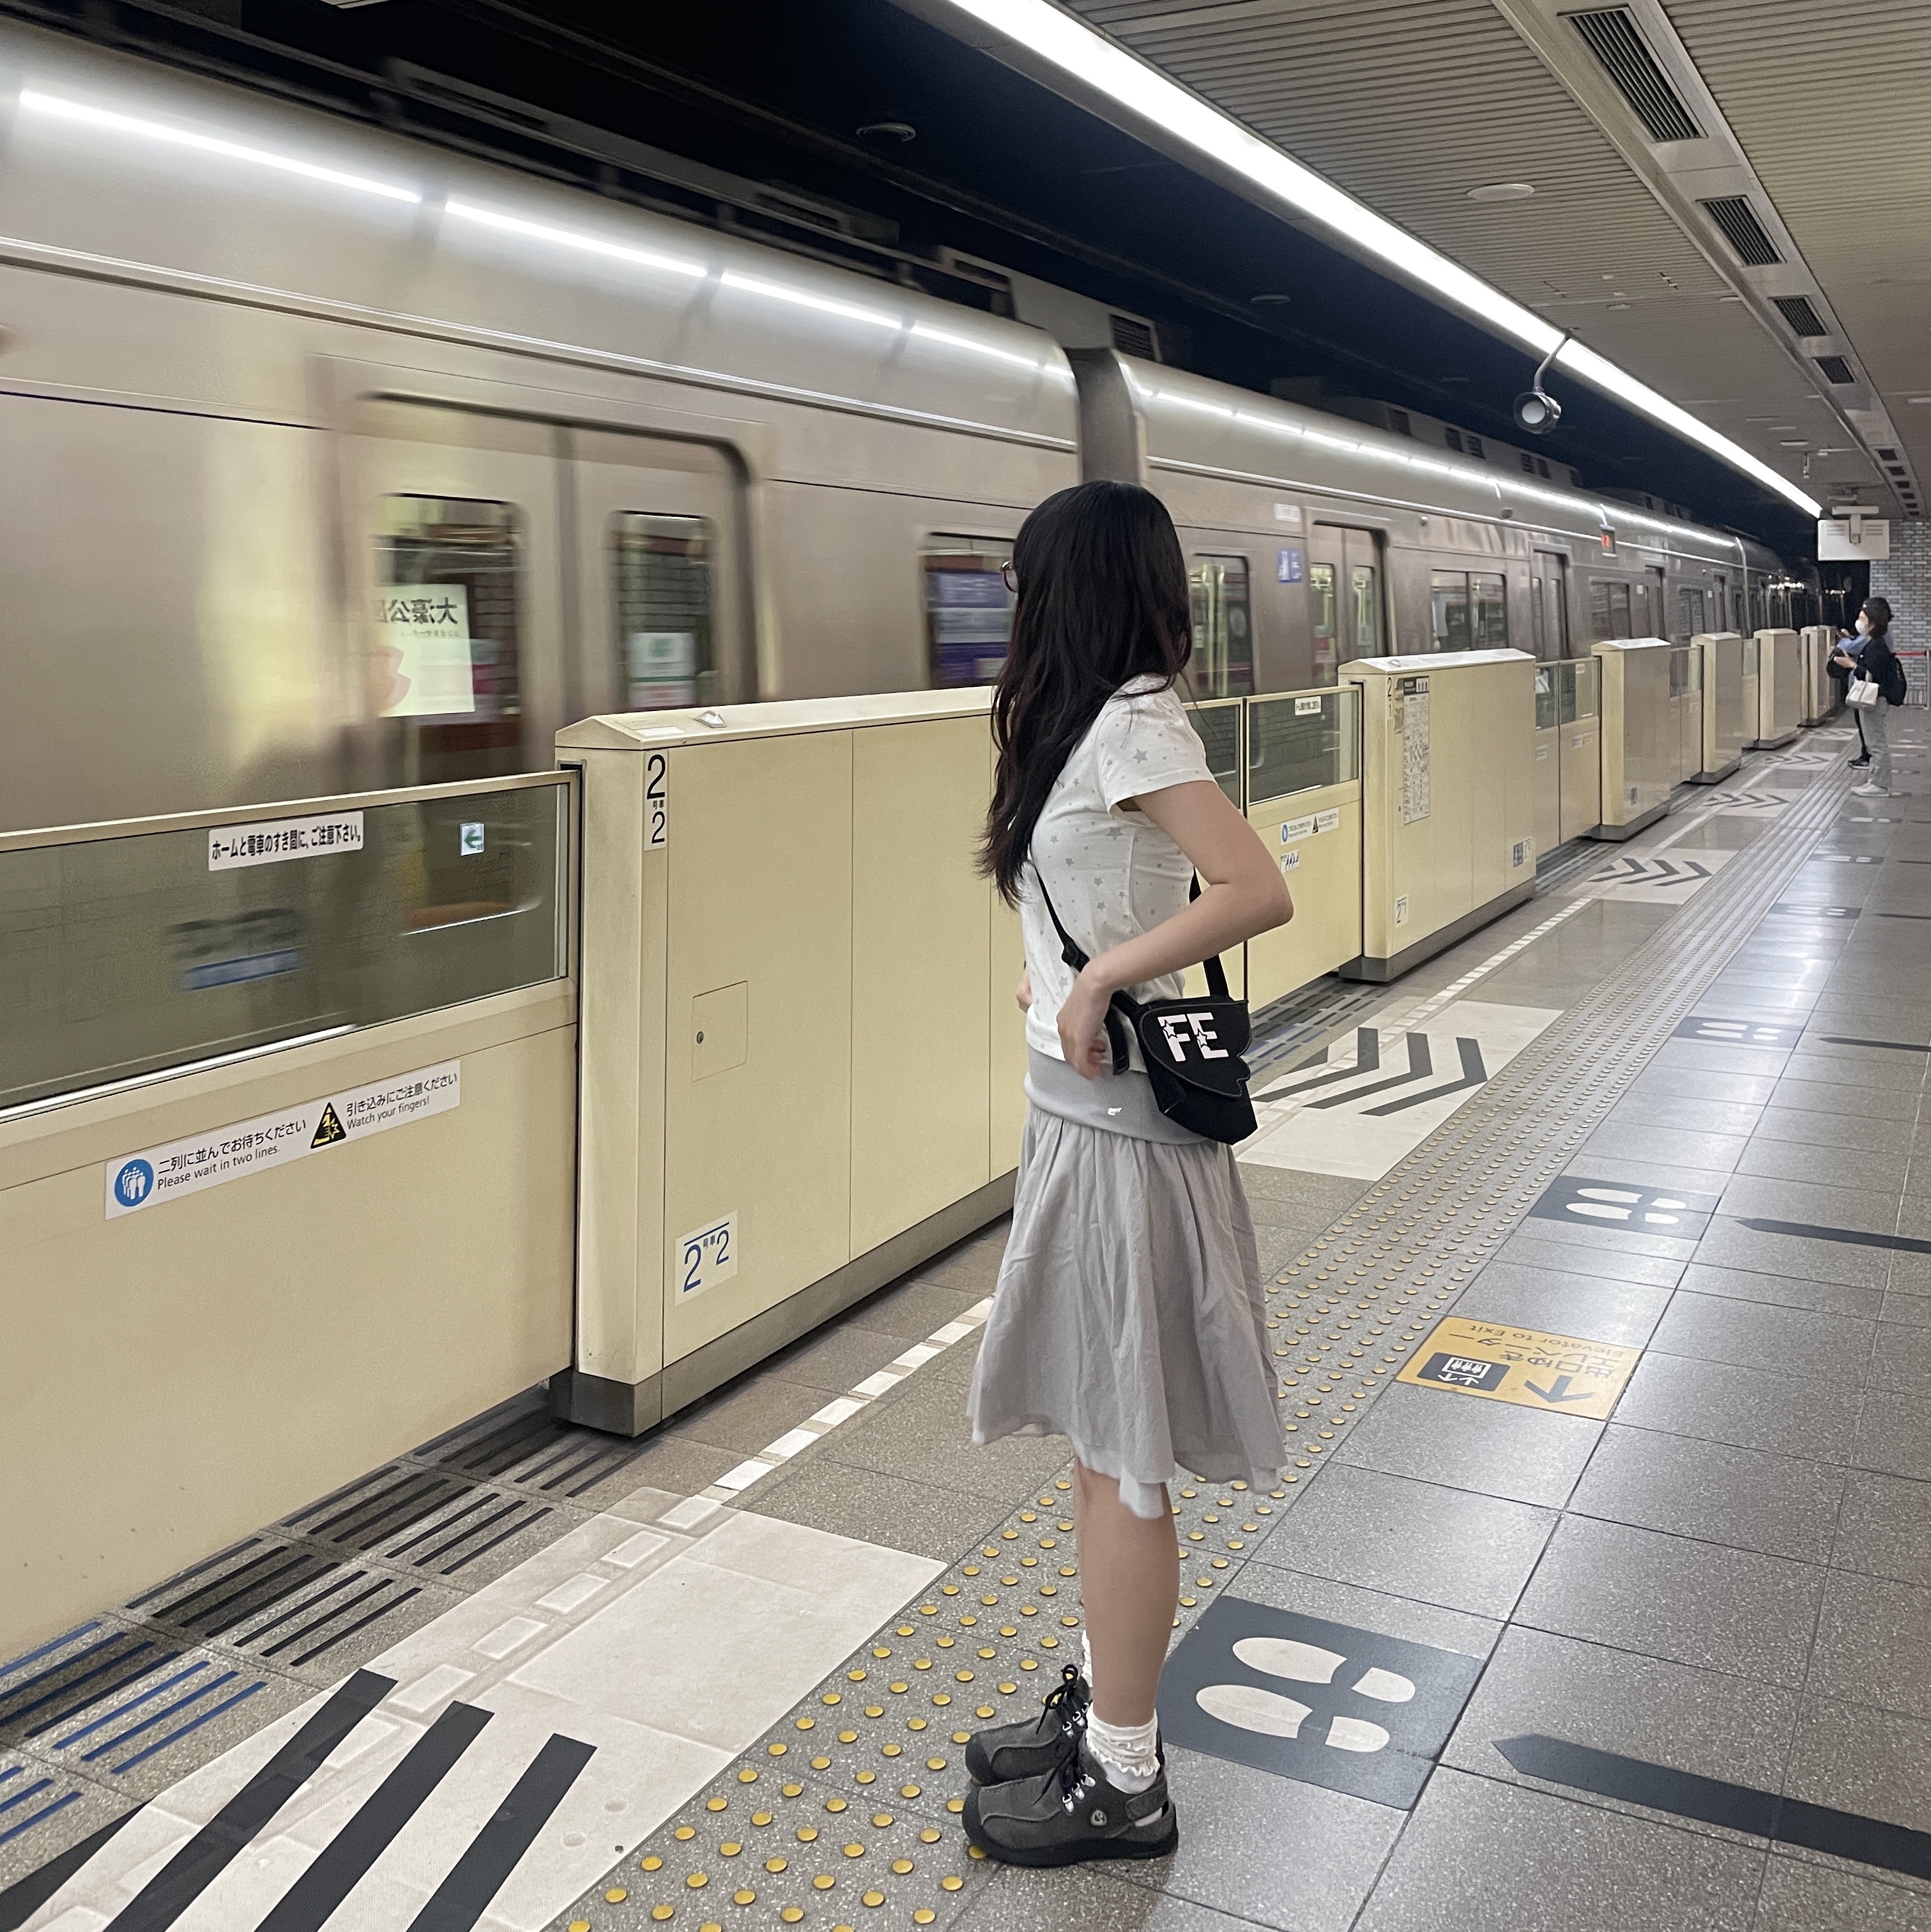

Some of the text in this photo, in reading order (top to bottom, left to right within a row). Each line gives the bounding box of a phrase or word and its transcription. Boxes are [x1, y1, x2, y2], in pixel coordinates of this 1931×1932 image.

[1387, 677, 1392, 697] 2
[646, 754, 666, 799] 2
[651, 811, 665, 844] 2
[1157, 1012, 1229, 1062] FE
[346, 1073, 457, 1117] 引き込みにご注意ください
[347, 1095, 430, 1130] Watch your fingers!
[158, 1119, 306, 1174] 二列に並んでお待ちください
[158, 1144, 280, 1190] Please wait in two lines.
[683, 1244, 701, 1292] 2
[716, 1229, 729, 1265] 2
[1469, 1324, 1505, 1337] Exit
[1539, 1338, 1624, 1358] Elevator
[1449, 1333, 1621, 1368] エレベーター
[1499, 1350, 1613, 1378] 出口ゆき
